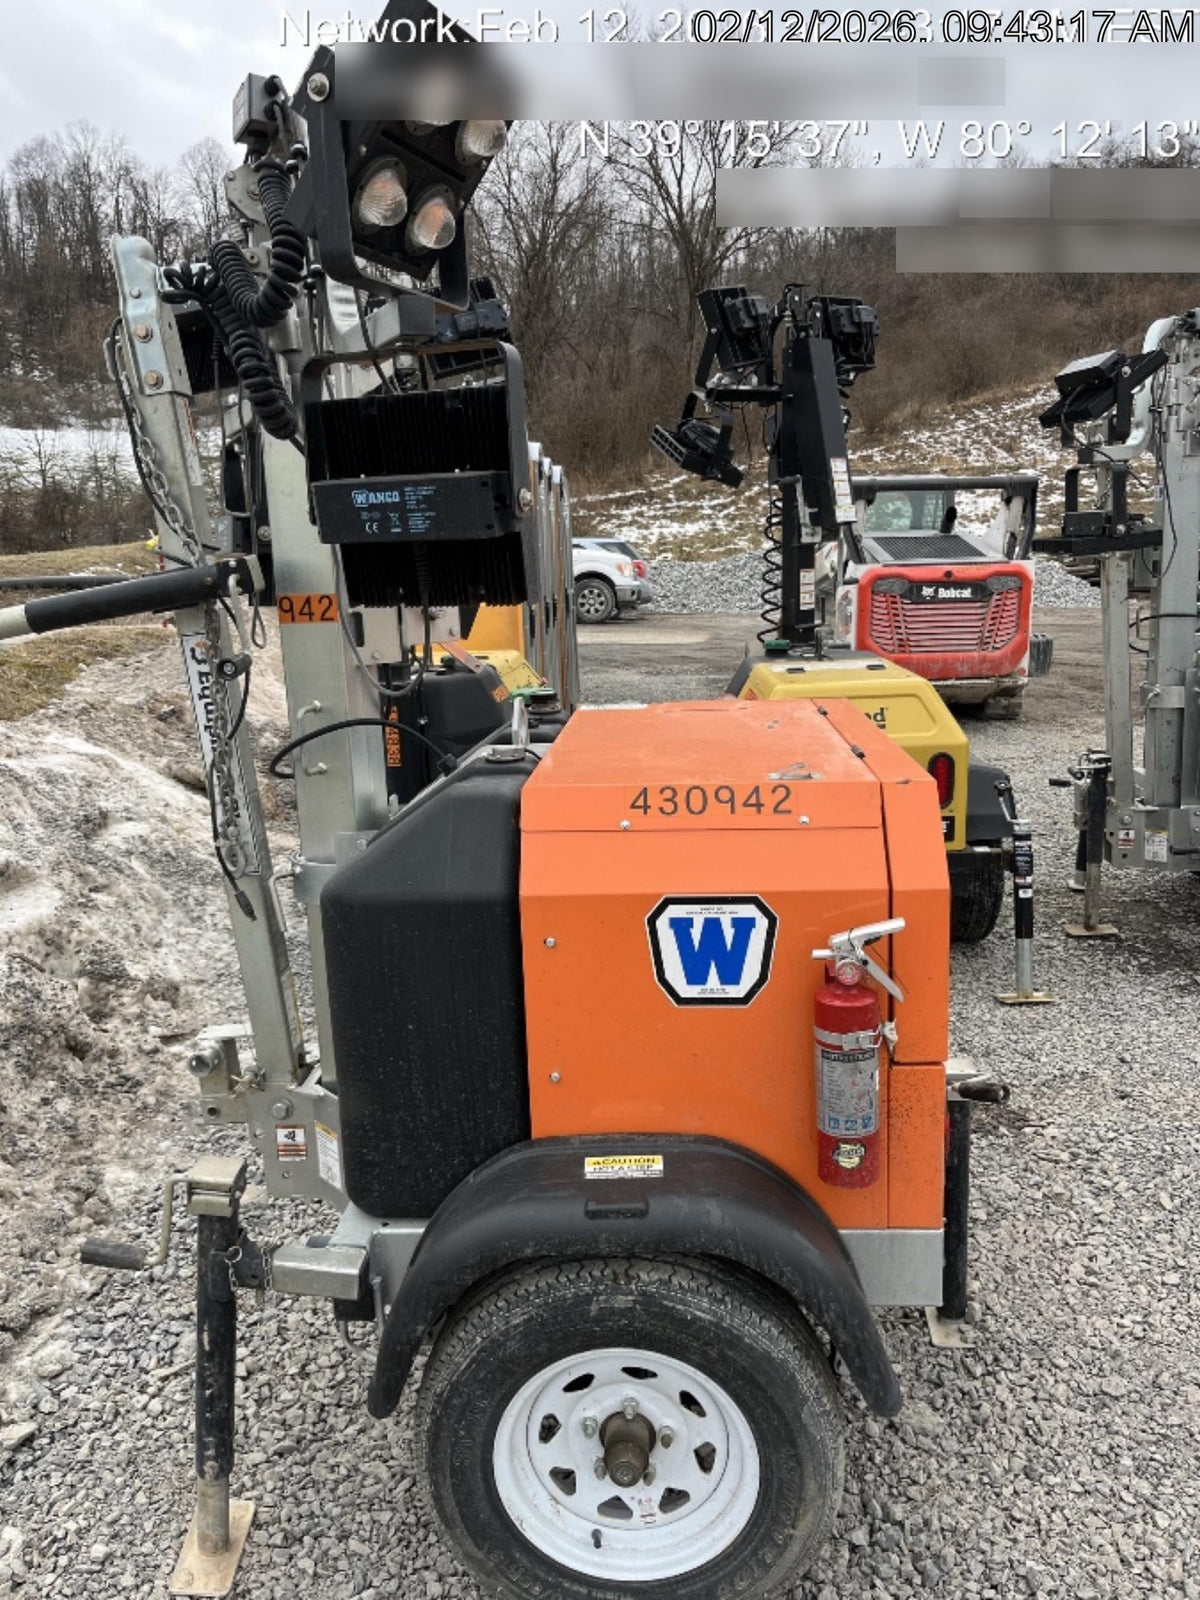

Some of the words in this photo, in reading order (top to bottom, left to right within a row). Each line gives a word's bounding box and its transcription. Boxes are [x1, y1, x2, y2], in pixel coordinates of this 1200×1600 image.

[352, 489, 400, 507] WANCO
[938, 587, 973, 598] Bobcat
[279, 595, 335, 622] 942
[630, 784, 793, 815] 430942
[668, 917, 756, 985] W
[602, 1157, 656, 1165] CAUTION
